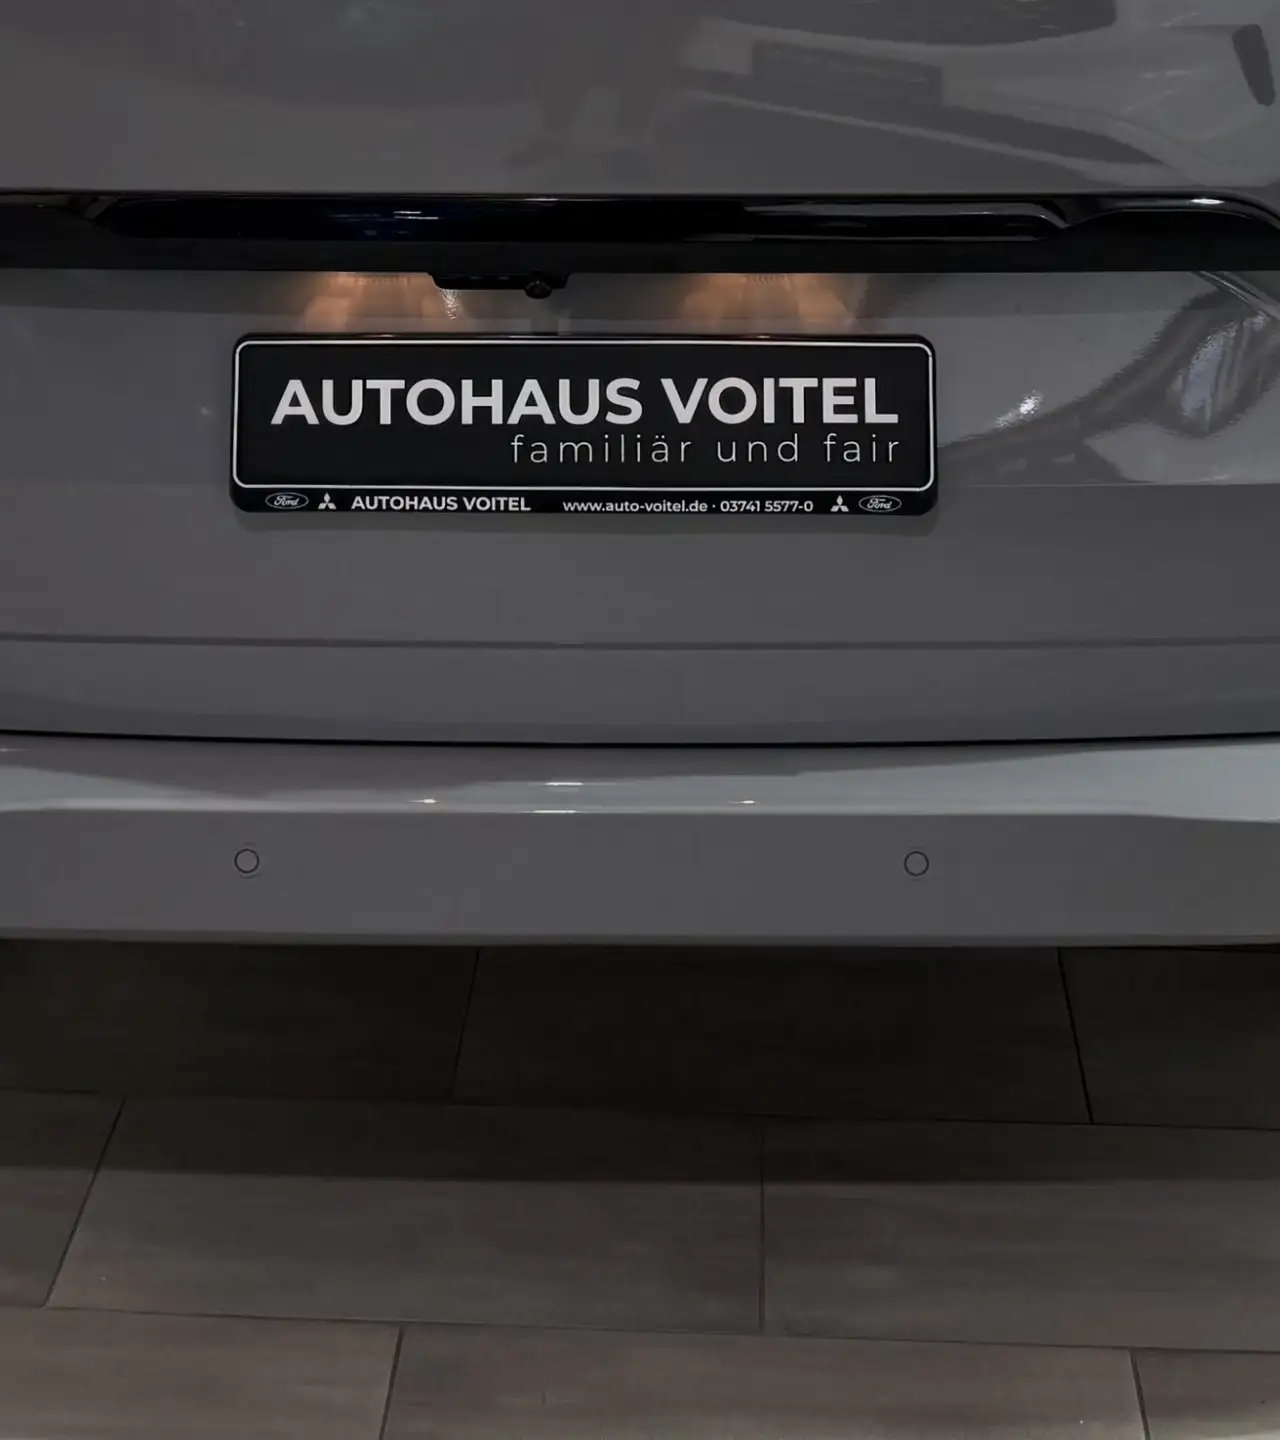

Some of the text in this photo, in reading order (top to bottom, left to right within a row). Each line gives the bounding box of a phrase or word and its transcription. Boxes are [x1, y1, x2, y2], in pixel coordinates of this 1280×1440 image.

[270, 377, 899, 425] AUTOHAUS VOITEL
[511, 432, 899, 463] familiär und fair
[351, 496, 531, 511] AUTOHAUS VOITEL
[563, 499, 813, 512] www.auto-voitel.de 03741 5577-0
